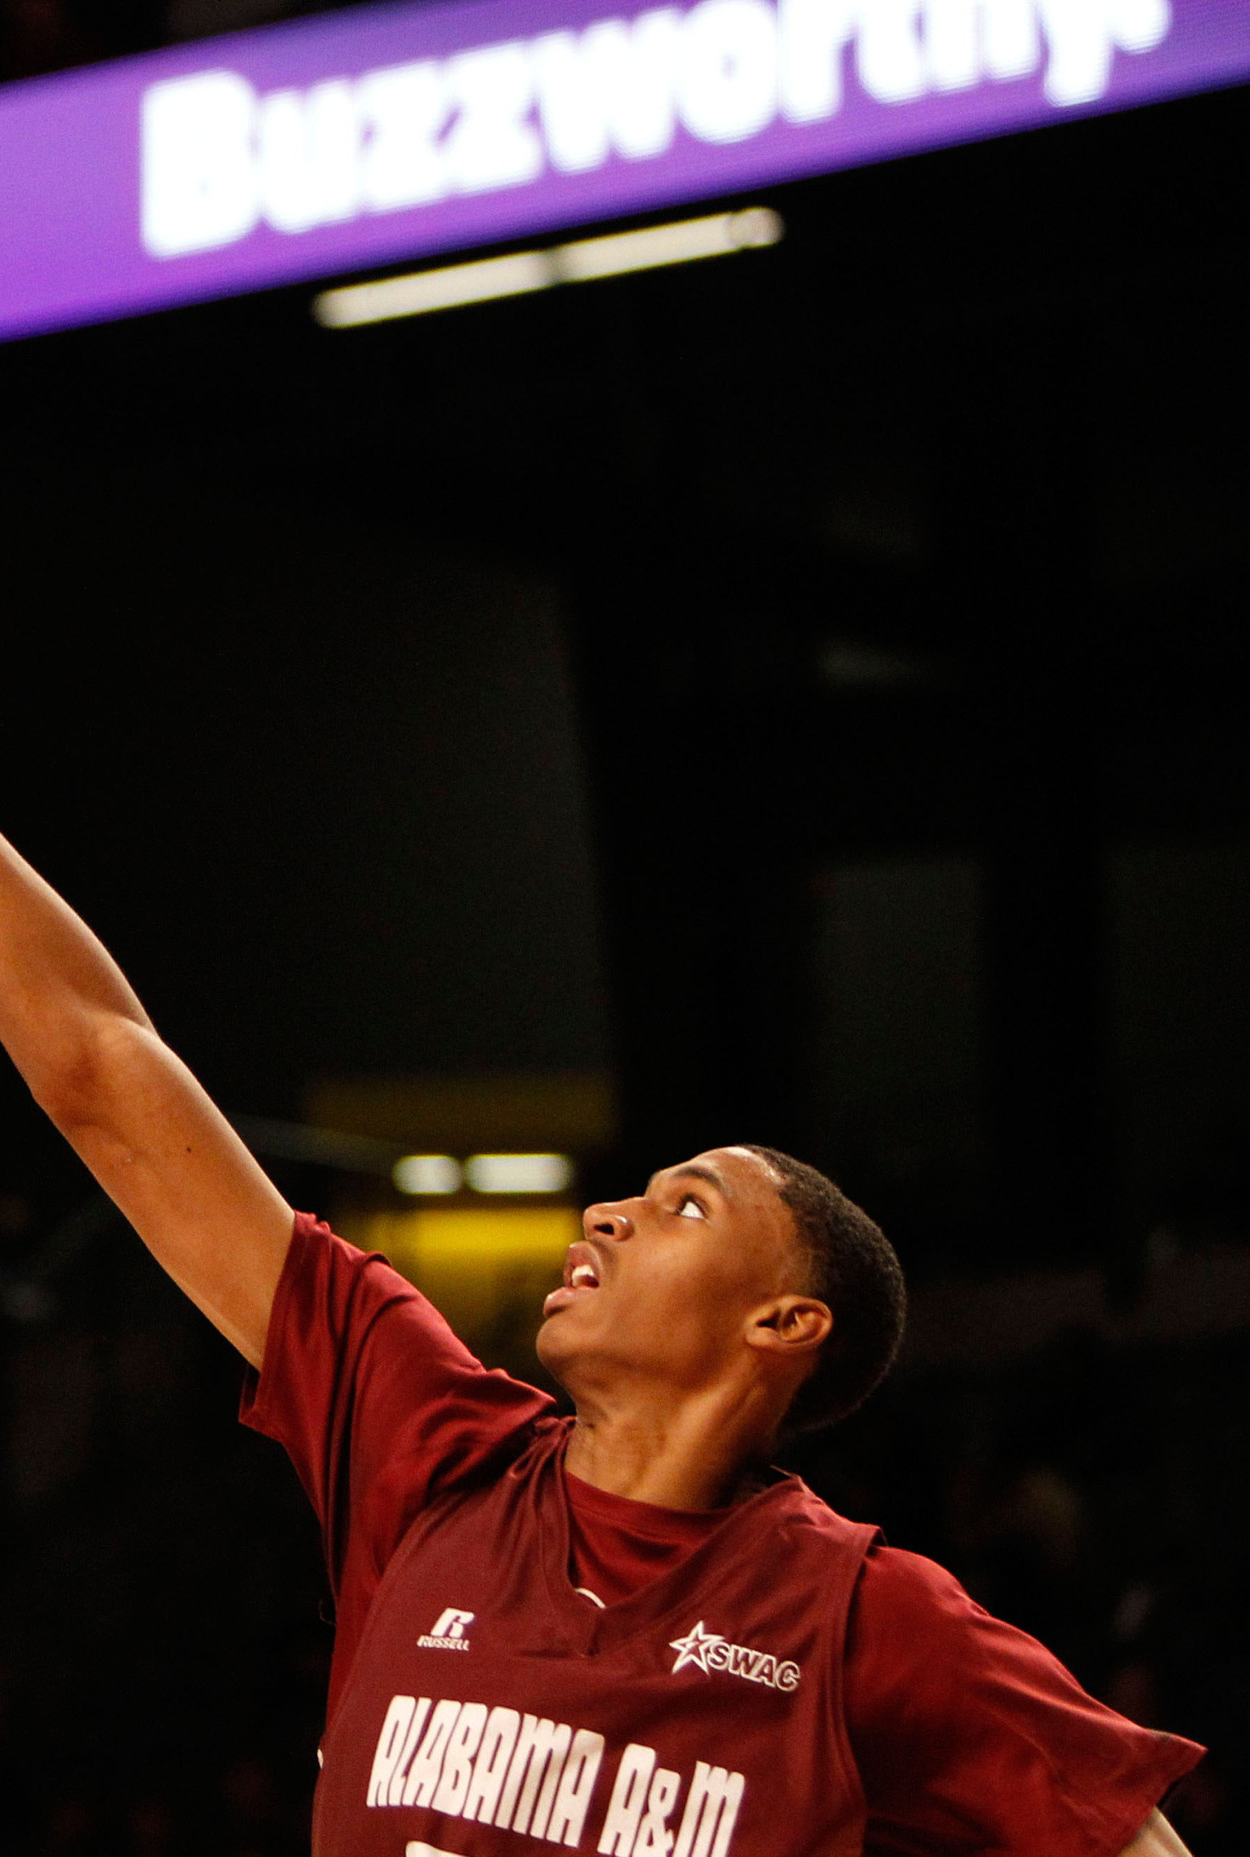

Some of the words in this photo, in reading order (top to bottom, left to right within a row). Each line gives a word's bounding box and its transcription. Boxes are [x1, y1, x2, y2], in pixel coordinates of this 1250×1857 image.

[417, 1634, 470, 1651] RUSSELL
[707, 1640, 800, 1692] SWAC
[367, 1694, 605, 1848] ALABAMA
[597, 1743, 745, 1857] A&M
